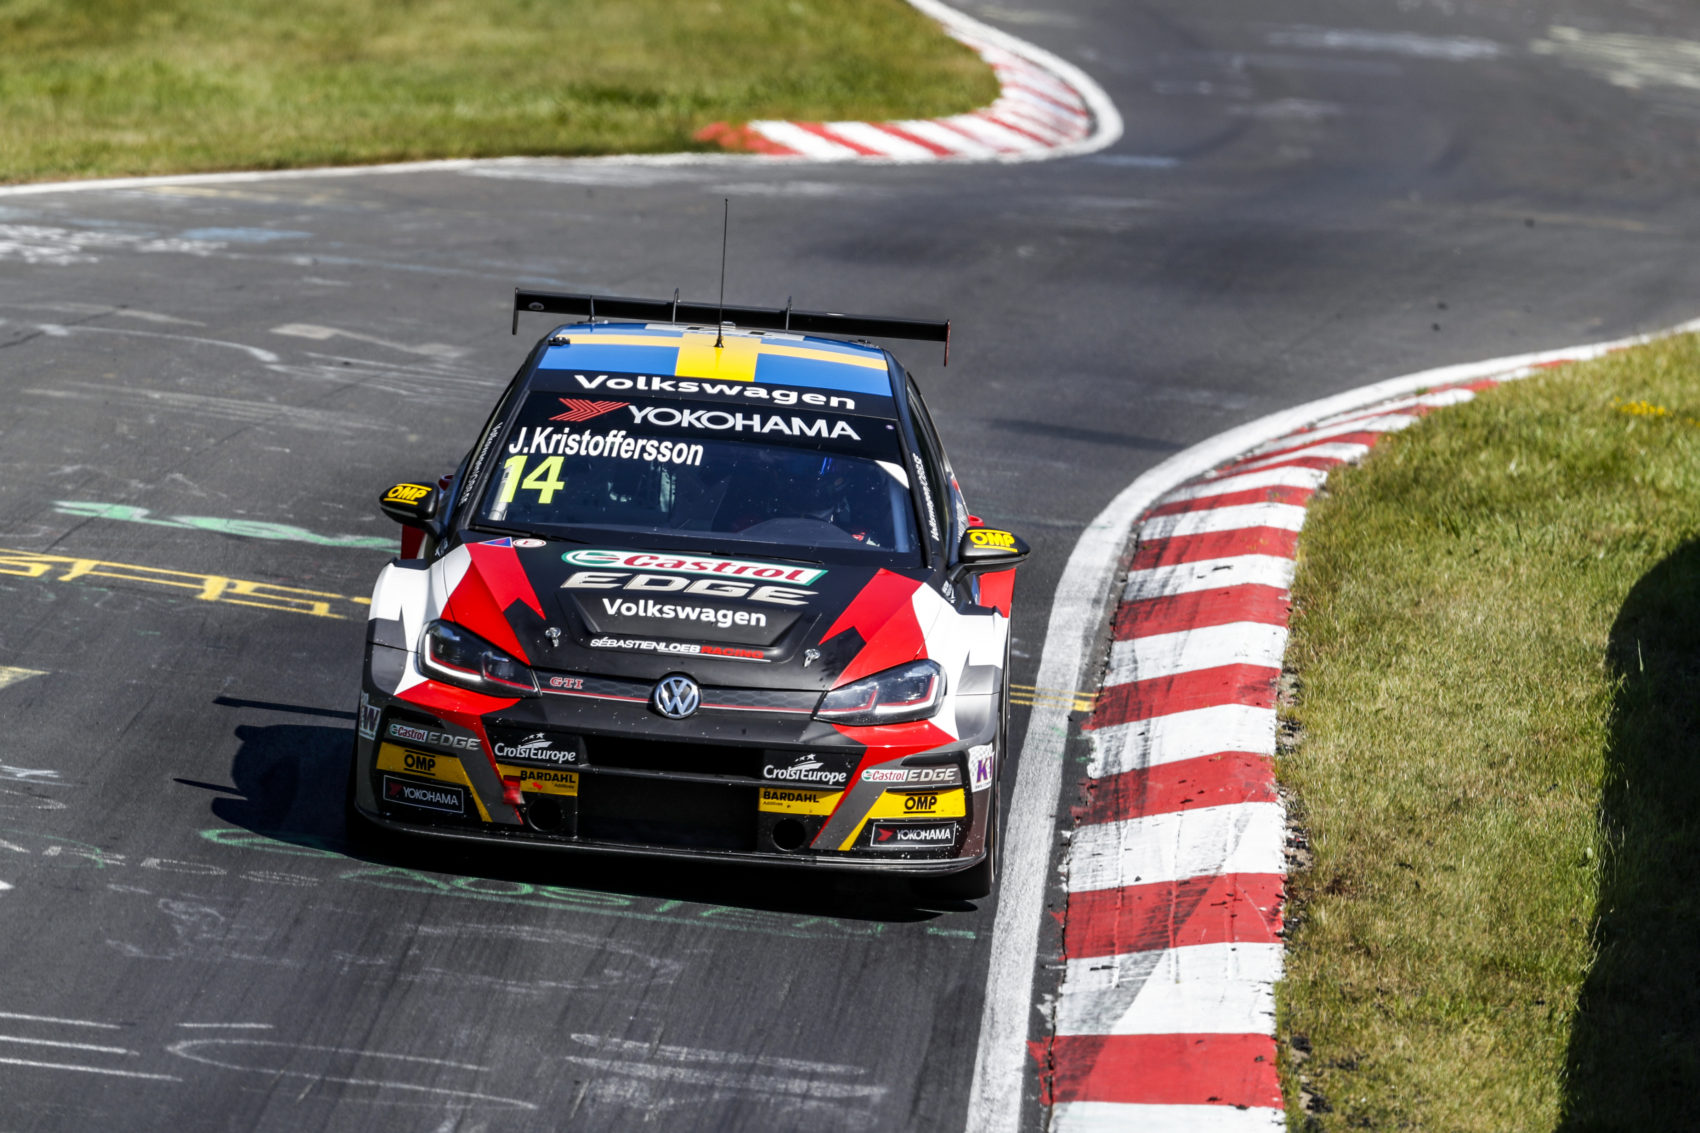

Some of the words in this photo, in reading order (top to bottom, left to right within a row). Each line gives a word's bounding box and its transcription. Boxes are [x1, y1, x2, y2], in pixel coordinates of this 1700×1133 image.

[573, 374, 856, 410] Volkswagen
[628, 404, 862, 441] YOKOHAMA
[508, 426, 704, 467] J.Kristoffersson
[500, 455, 566, 504] 14
[387, 485, 429, 501] OMP
[969, 531, 1016, 548] OMP
[622, 553, 806, 582] Castrol
[560, 571, 820, 606] EDGE
[602, 598, 767, 628] Volkswagen
[550, 676, 584, 690] GTI
[397, 725, 427, 742] Castrol
[428, 732, 481, 751] EDGE
[404, 754, 436, 772] OMP
[494, 742, 577, 764] CroisiEurope
[520, 770, 577, 784] BARDAHL
[763, 764, 847, 785] CroisiEurope
[872, 770, 906, 782] Castrol
[907, 768, 957, 782] EDGE
[403, 786, 459, 806] YOKOHAMA
[763, 790, 820, 803] BARDAHL
[904, 795, 937, 811] OMP
[896, 828, 951, 840] YOKOHAMA
